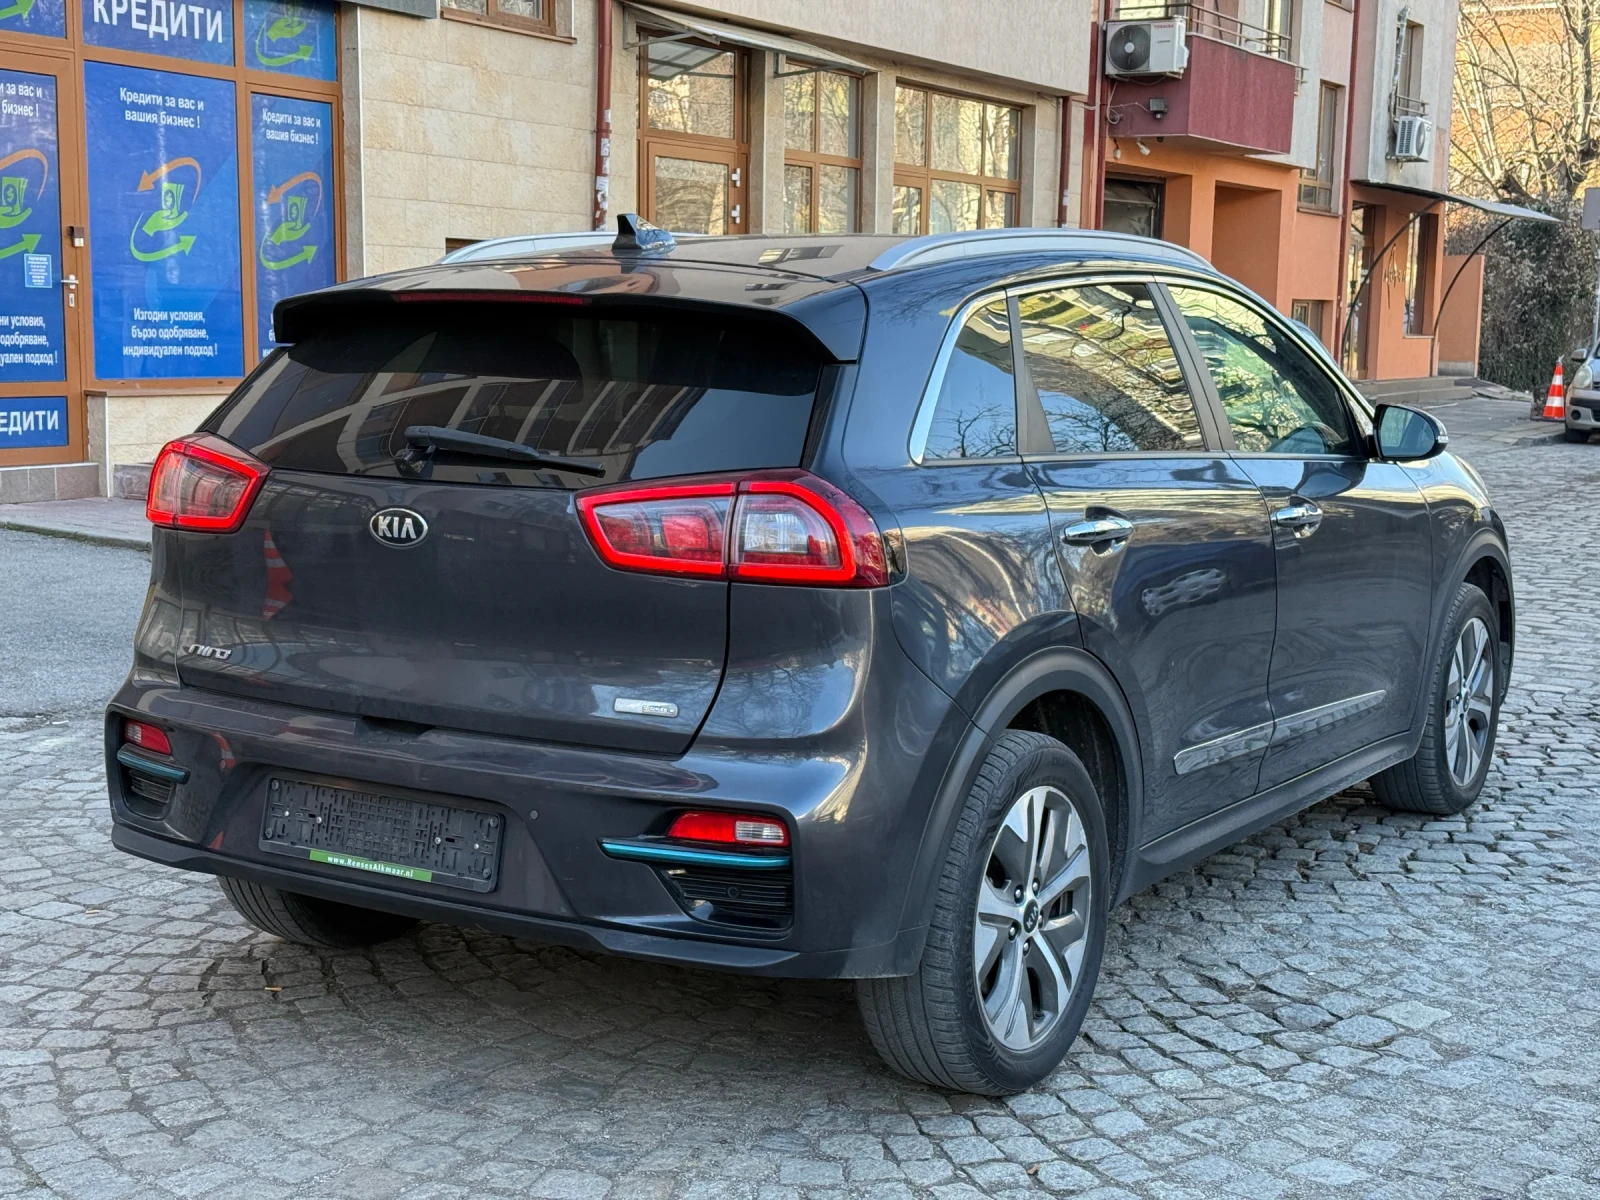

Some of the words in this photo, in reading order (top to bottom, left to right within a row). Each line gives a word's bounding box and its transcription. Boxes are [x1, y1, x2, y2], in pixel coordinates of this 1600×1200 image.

[93, 0, 223, 43] КРЕДИТИ
[5, 83, 16, 95] за
[18, 84, 35, 97] вас
[36, 86, 43, 98] и
[120, 87, 163, 106] Кредити
[164, 96, 176, 108] за
[178, 98, 196, 110] вас
[197, 100, 204, 111] и
[1, 99, 34, 117] бизнес
[124, 109, 158, 124] вашия
[160, 111, 195, 128] бизнес
[262, 107, 293, 125] Кредити
[293, 115, 302, 126] за
[302, 116, 316, 128] вас
[316, 118, 321, 128] и
[265, 129, 290, 142] вашия
[290, 129, 315, 145] бизнес
[10, 315, 46, 330] условия,
[133, 307, 168, 323] Изгодни
[169, 310, 206, 324] условия,
[0, 331, 49, 349] одобряване,
[131, 325, 157, 341] бързо
[158, 325, 209, 341] одобряване,
[24, 353, 54, 366] подход
[122, 345, 183, 359] индивидуален
[183, 345, 214, 358] подход
[0, 410, 59, 436] ЕДИТИ
[378, 515, 417, 539] KIA
[327, 855, 414, 878] www.RensesAlkmaar.nl
[1025, 905, 1039, 929] KIA
